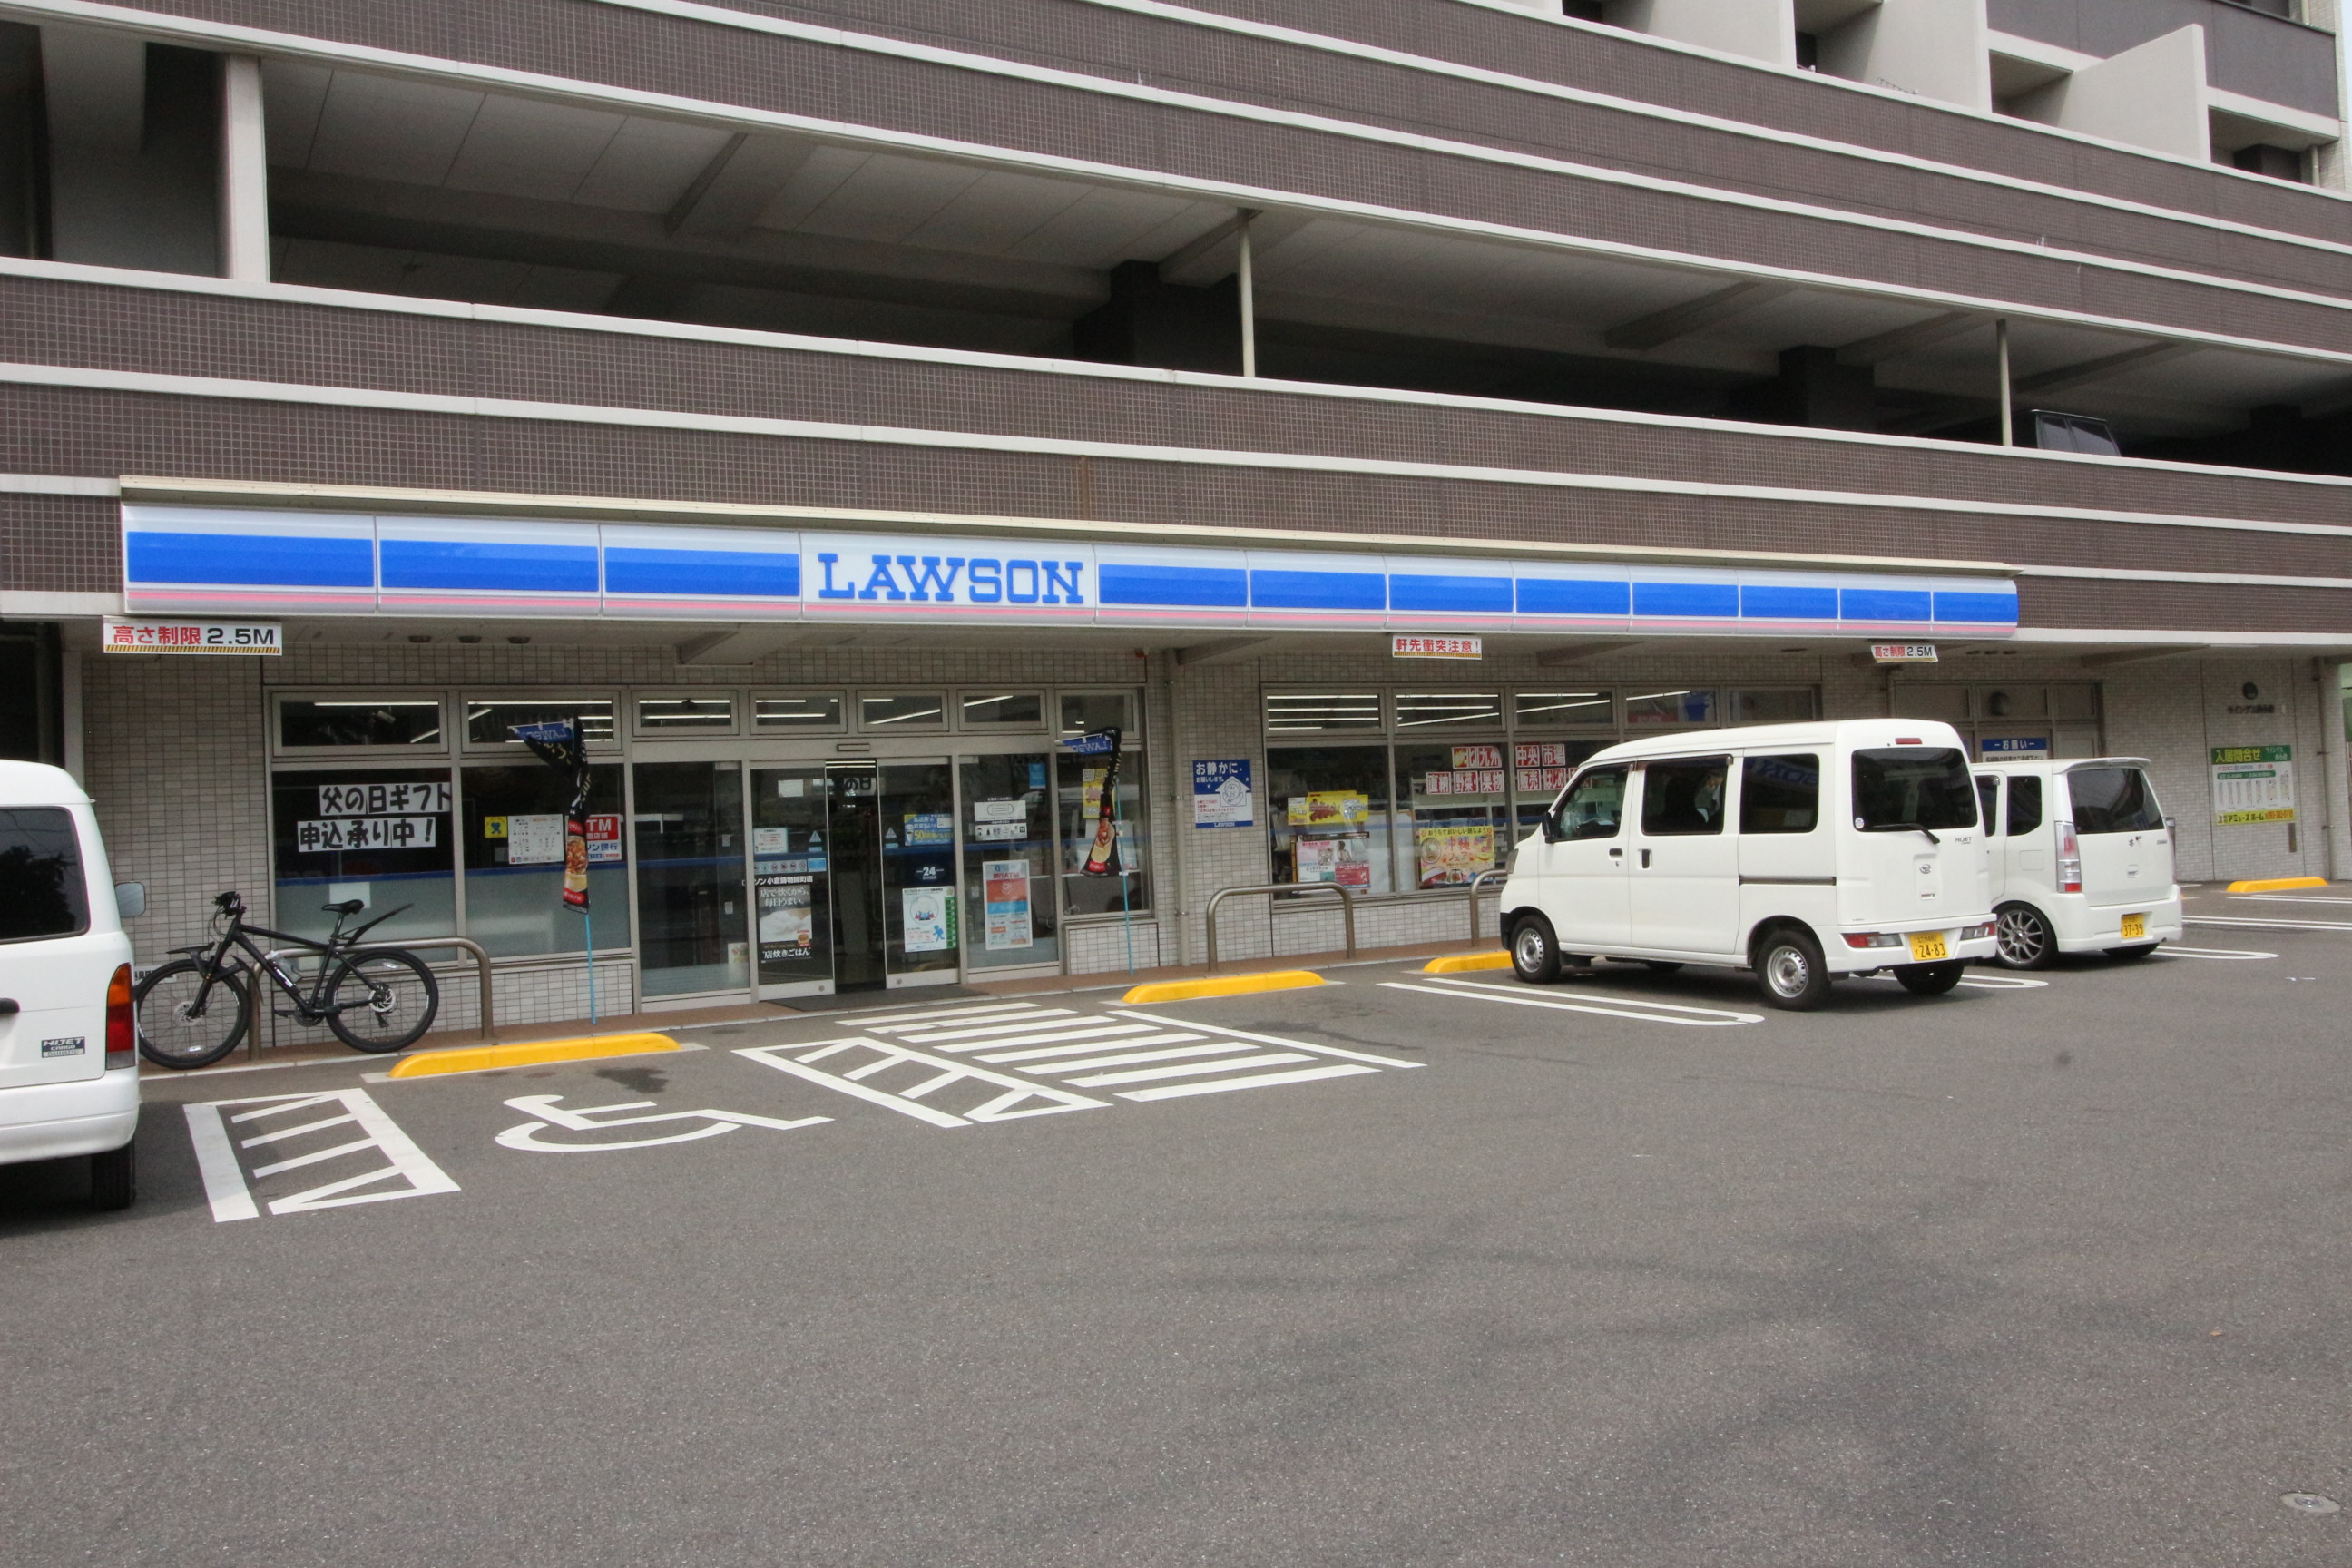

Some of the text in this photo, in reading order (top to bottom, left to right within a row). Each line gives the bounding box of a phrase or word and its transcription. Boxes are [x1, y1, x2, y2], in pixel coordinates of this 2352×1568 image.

[818, 553, 1083, 604] LAWSON
[113, 625, 274, 645] 高さ制限 2.5M
[1874, 646, 1933, 657] 高さ制限 2.5M
[2215, 748, 2261, 763] 入居問合せ
[1195, 761, 1238, 776] お静かに
[322, 783, 451, 814] 父の日ギフト
[586, 818, 612, 832] TM
[299, 818, 434, 851] 申込承り中!
[922, 866, 936, 877] 24
[43, 1037, 84, 1047] HIJET
